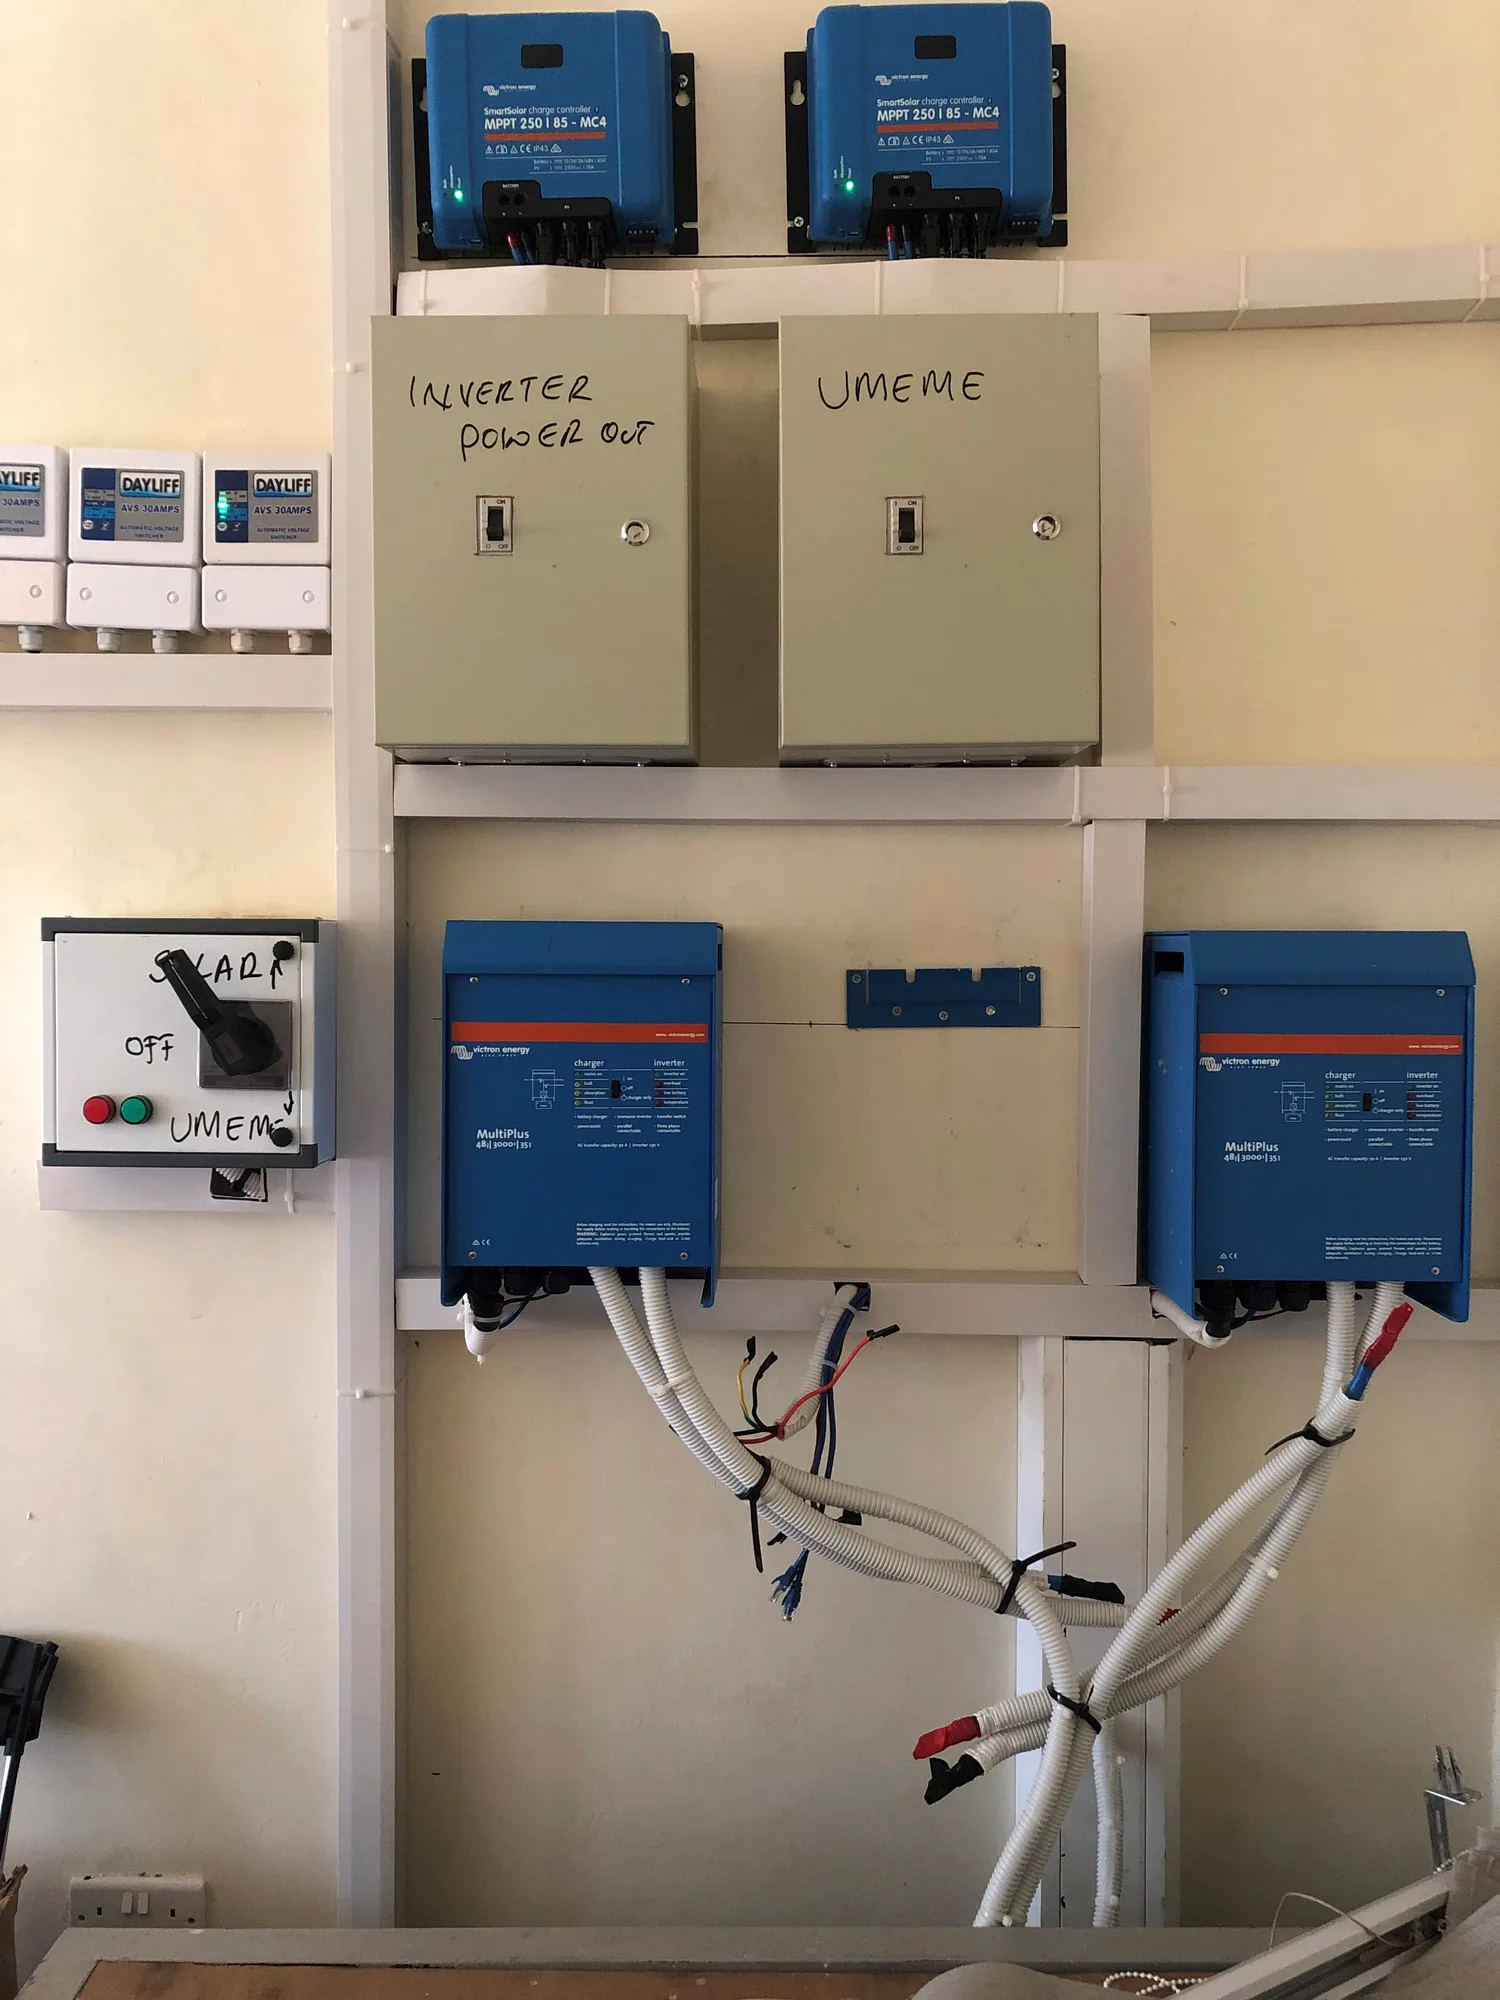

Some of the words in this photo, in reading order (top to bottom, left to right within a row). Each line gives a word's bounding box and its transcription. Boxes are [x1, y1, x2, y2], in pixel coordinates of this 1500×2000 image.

[877, 98, 920, 107] SmartSolar
[922, 97, 948, 106] charge
[950, 96, 984, 104] controller
[484, 107, 527, 116] SmartSolar
[528, 106, 555, 116] charge
[556, 105, 592, 114] controller
[876, 110, 910, 122] MPPT
[912, 108, 936, 120] 250
[946, 108, 961, 119] 85
[972, 106, 1000, 118] MC4
[484, 118, 517, 130] MPPT
[520, 117, 542, 130] 250
[553, 116, 568, 128] 85
[580, 116, 607, 128] MC4
[925, 136, 941, 144] IP43
[534, 144, 549, 152] IP43
[410, 374, 593, 412] INVERTER
[818, 370, 985, 410] UMEME
[460, 418, 584, 463] POWER
[122, 478, 180, 493] DAYLIFF
[256, 478, 311, 492] DAYLIFF
[120, 504, 140, 512] AVS
[142, 504, 180, 514] 30AMPS
[254, 506, 272, 514] AVS
[274, 506, 312, 514] 30AMPS
[149, 950, 262, 983] SLAR
[125, 1032, 175, 1064] OFF
[472, 1046, 500, 1054] victron
[502, 1046, 530, 1055] energy
[574, 1059, 604, 1069] charger
[654, 1059, 686, 1067] inverter
[1252, 1058, 1280, 1066] energy
[1324, 1072, 1356, 1080] charger
[476, 1128, 530, 1139] MultiPlus
[1225, 1142, 1279, 1152] MultiPlus
